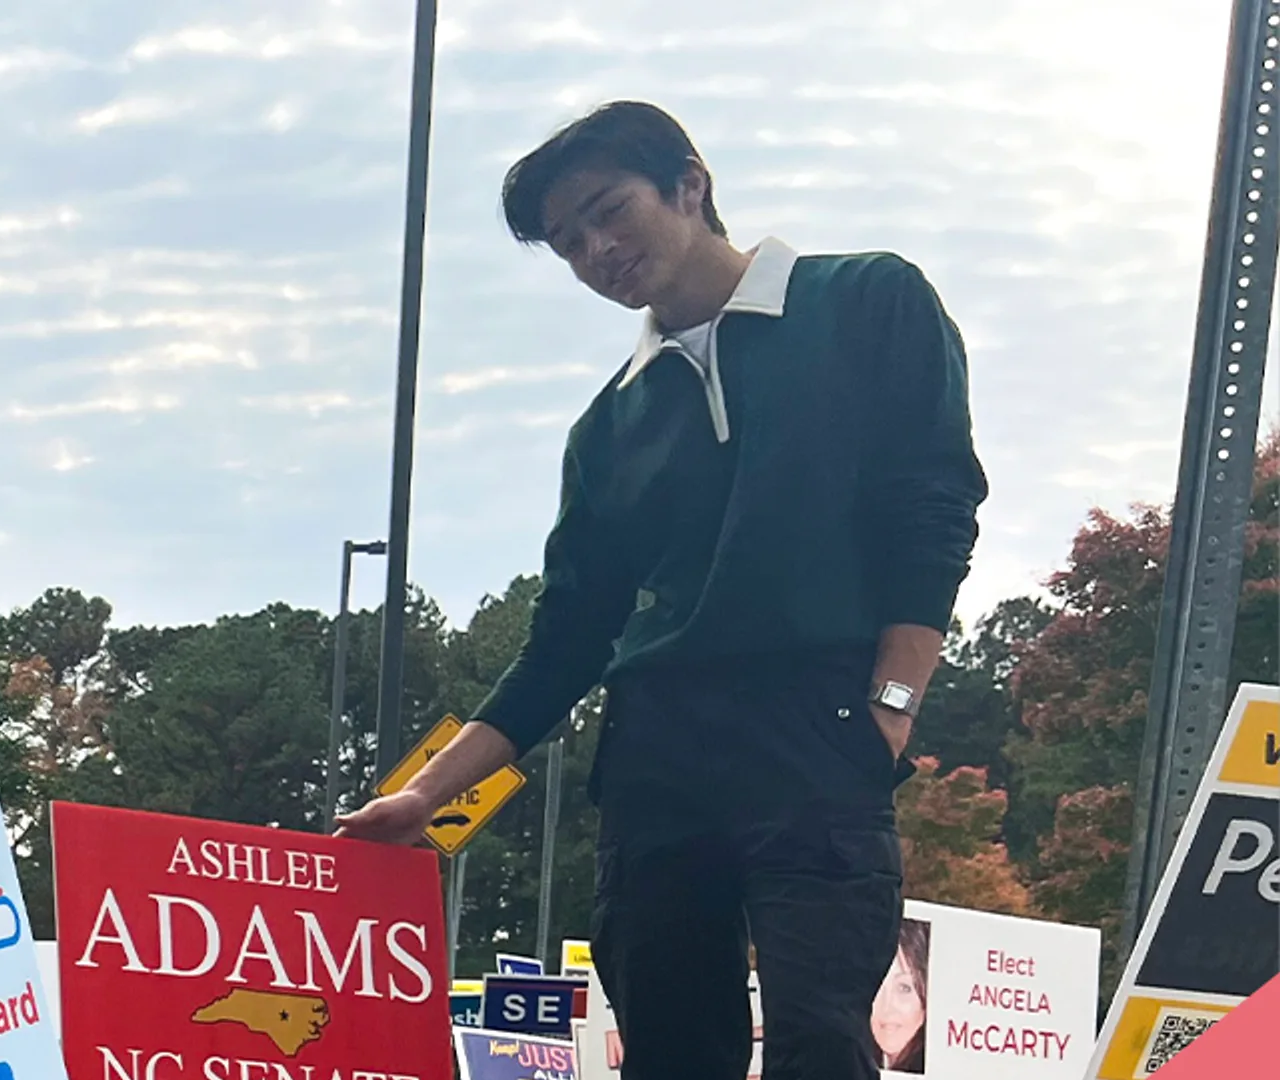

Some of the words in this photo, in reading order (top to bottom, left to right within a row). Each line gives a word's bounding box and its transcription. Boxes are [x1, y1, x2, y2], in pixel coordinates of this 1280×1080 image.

[167, 837, 339, 893] ASHLEE
[75, 888, 433, 1004] ADAMS
[987, 950, 1035, 976] Elect
[968, 984, 1052, 1014] ANGELA
[948, 1020, 1071, 1060] McCARTY
